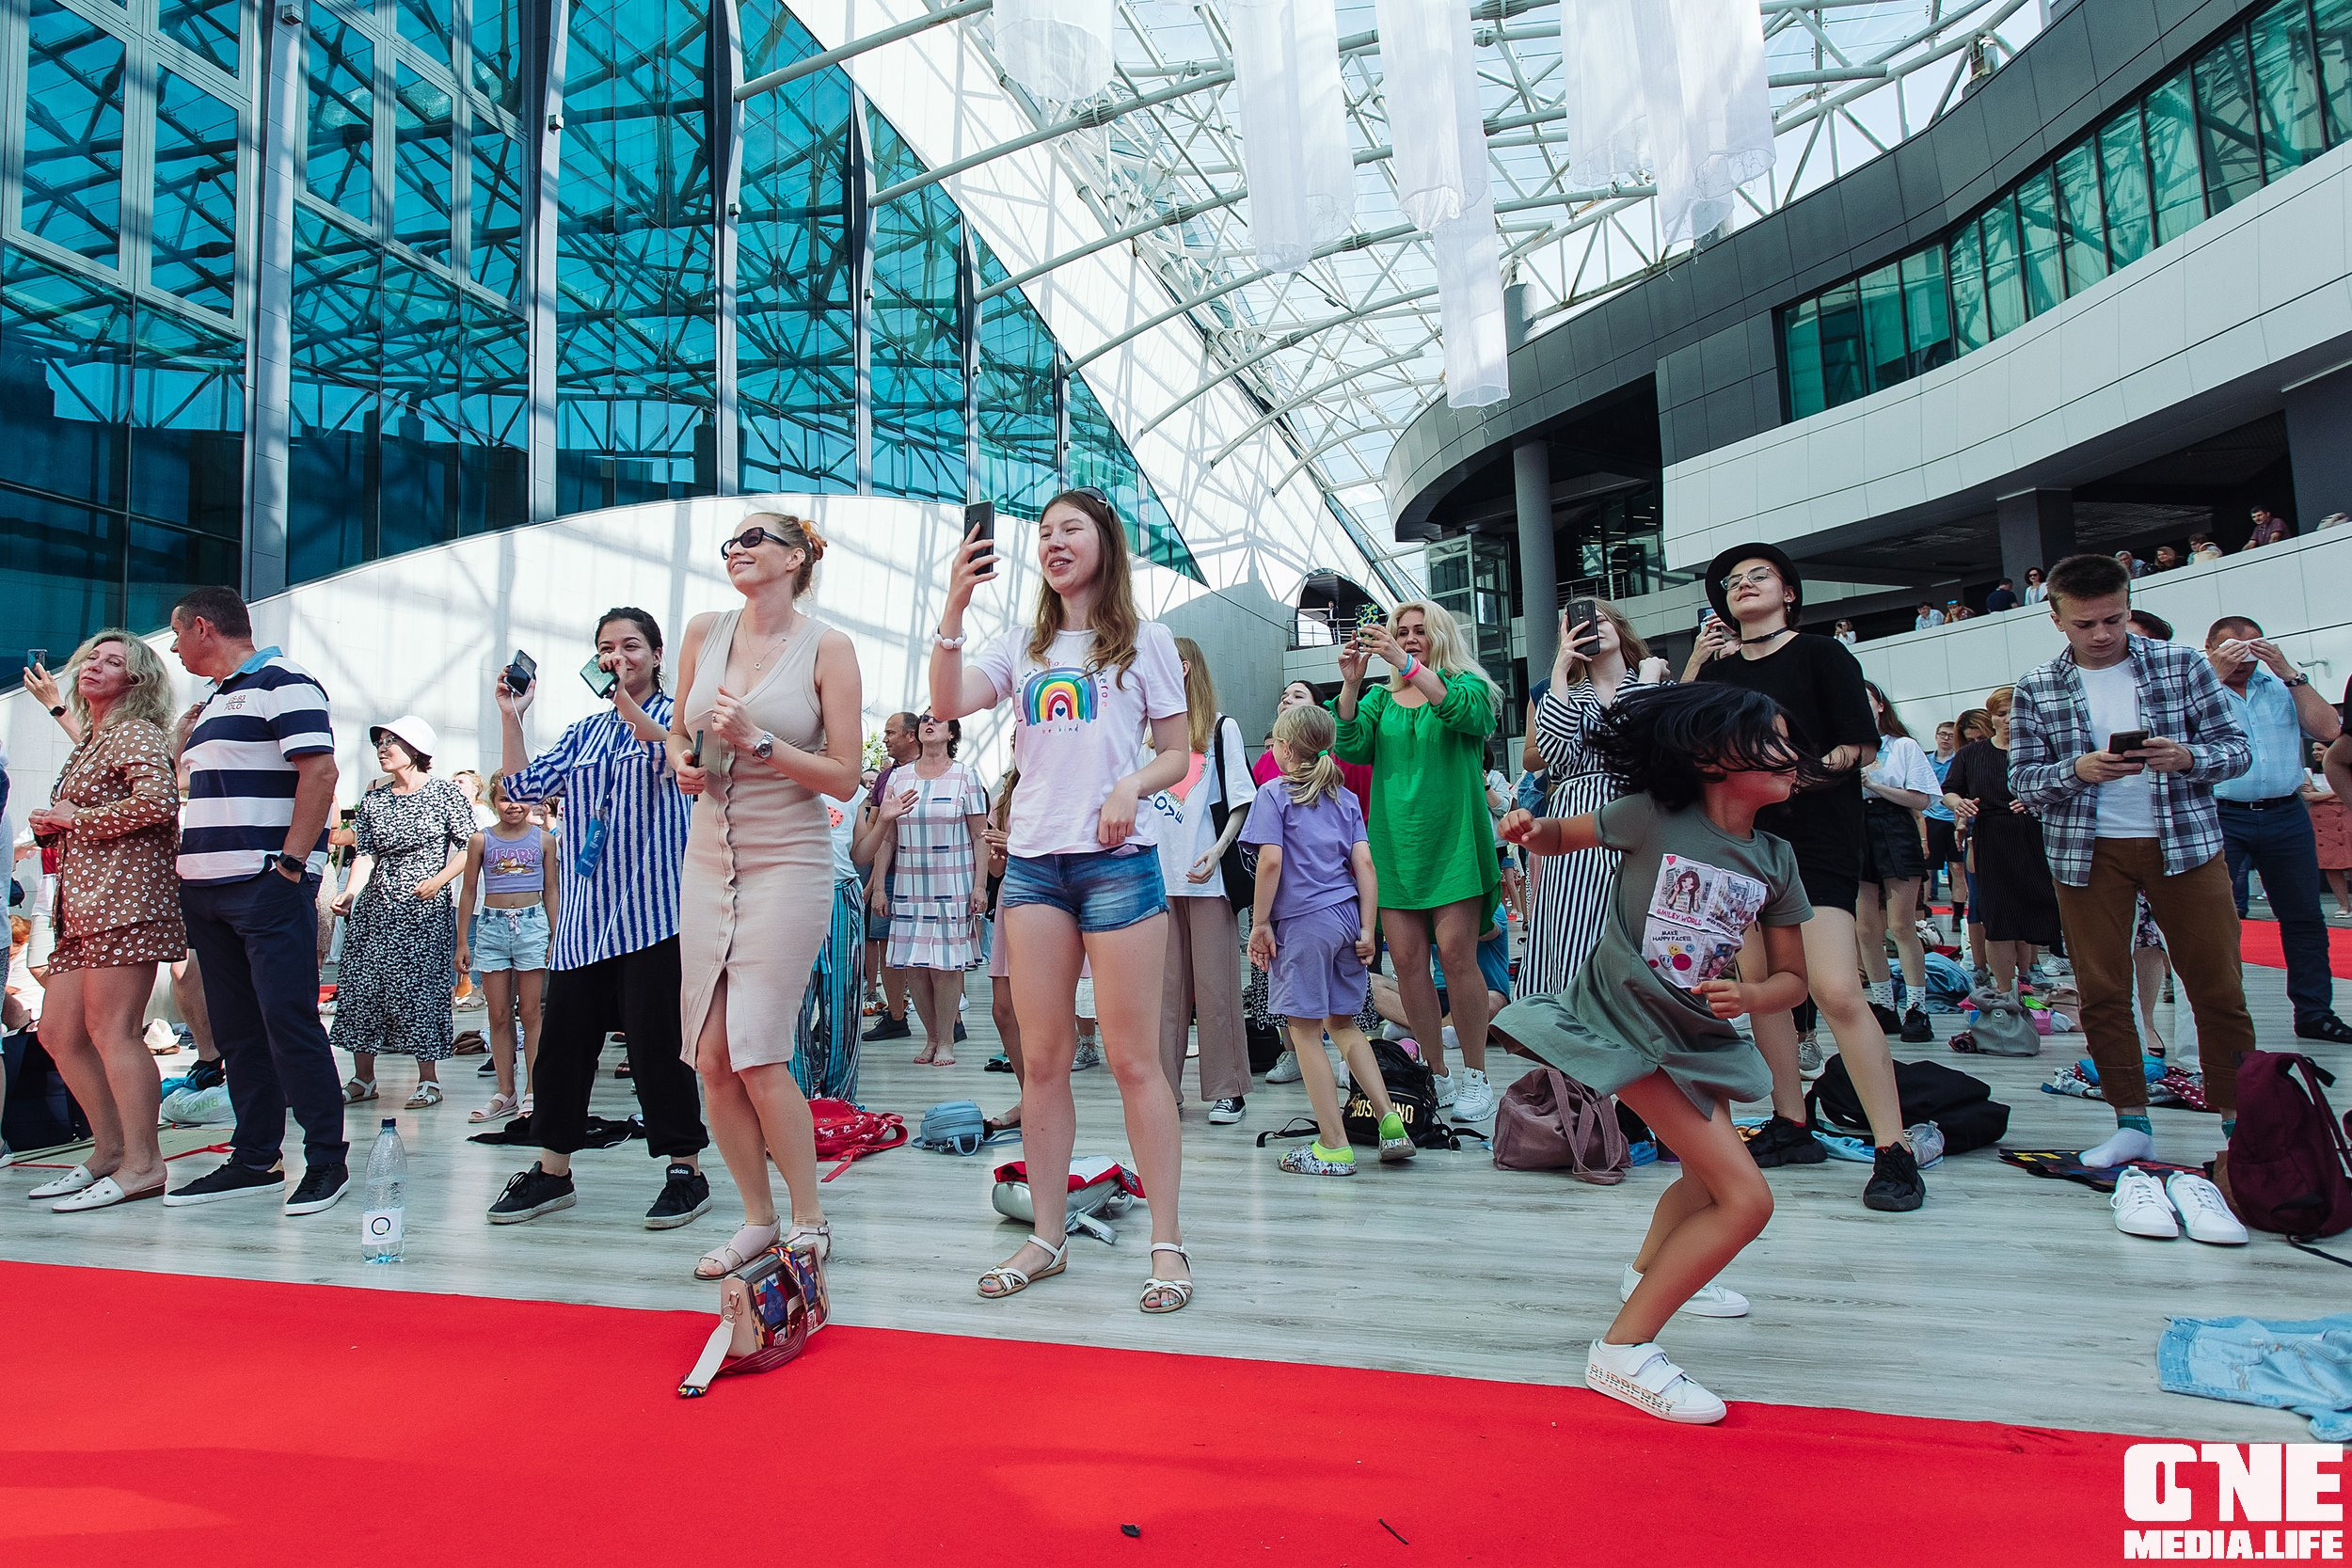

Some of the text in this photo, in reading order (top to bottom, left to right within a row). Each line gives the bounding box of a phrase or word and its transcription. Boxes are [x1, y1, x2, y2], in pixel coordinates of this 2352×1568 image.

[1152, 794, 1184, 824] OVE
[1656, 908, 1680, 920] SMILEY
[1681, 914, 1702, 927] WORLD
